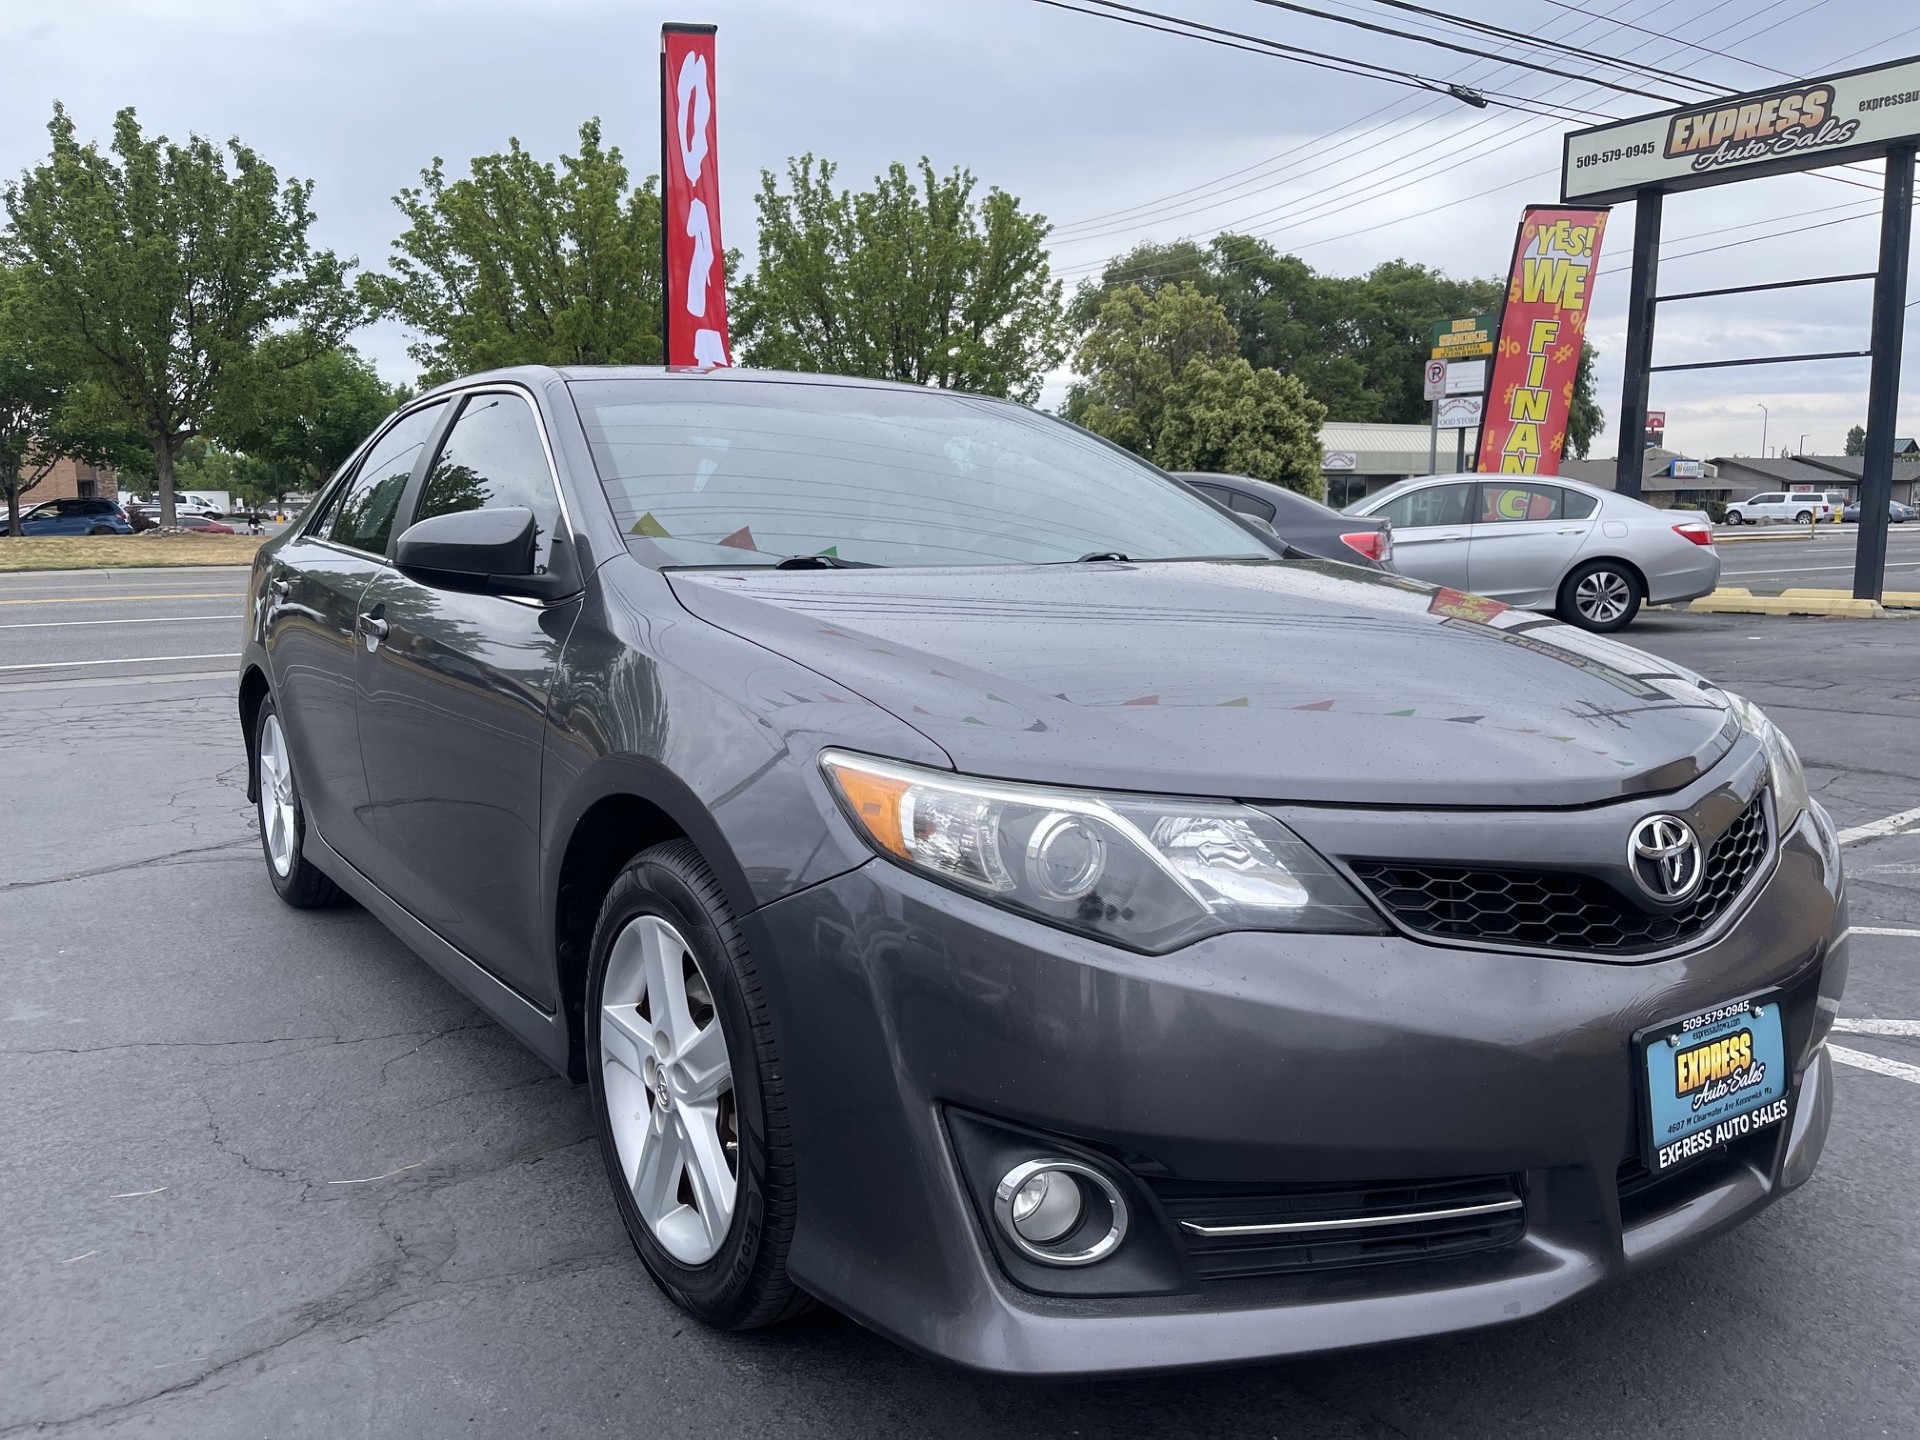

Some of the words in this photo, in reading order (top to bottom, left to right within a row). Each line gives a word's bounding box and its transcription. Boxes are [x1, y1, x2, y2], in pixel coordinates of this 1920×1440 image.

[1859, 89, 1920, 112] expressau
[1669, 89, 1830, 155] EXPRESS
[1576, 141, 1656, 169] 509-579-0945
[1695, 137, 1773, 168] Auto
[1773, 120, 1857, 152] Sales
[1537, 219, 1597, 257] YES!
[1522, 257, 1589, 311] WE
[1439, 418, 1456, 426] OOD
[1456, 416, 1479, 425] STORE
[1682, 1000, 1750, 1032] 509-579-0945
[1676, 1032, 1752, 1093] EXPRESS
[1693, 1079, 1730, 1109] Auto
[1730, 1061, 1764, 1093] Sales
[1693, 1106, 1723, 1124] Clearwater
[1715, 1114, 1750, 1144] AUTO
[1751, 1099, 1788, 1129] SALES
